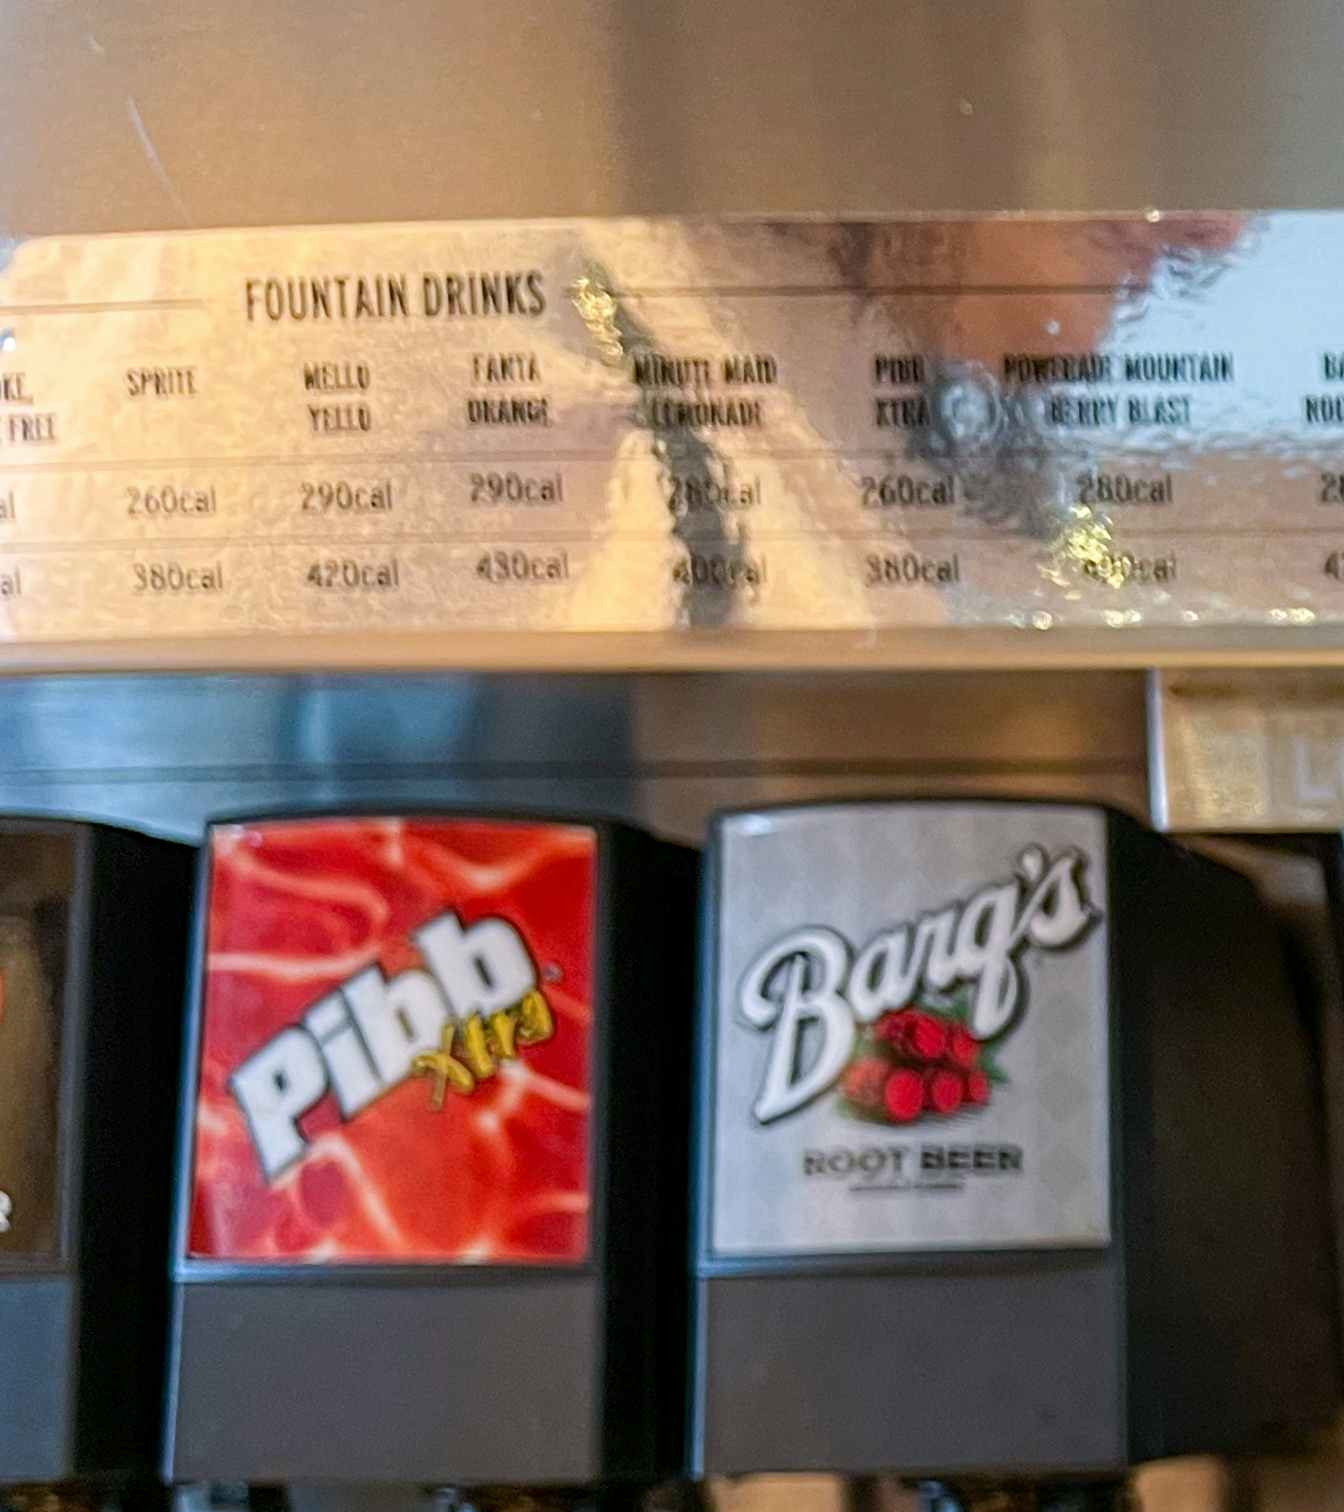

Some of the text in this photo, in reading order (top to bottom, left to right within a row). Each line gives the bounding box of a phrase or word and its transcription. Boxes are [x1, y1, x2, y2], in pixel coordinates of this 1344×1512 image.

[246, 270, 547, 321] FOUNTAIN DRINKS
[126, 366, 198, 397] SPRITE
[303, 361, 371, 391] MELLO
[471, 352, 542, 383] FANTA
[1124, 351, 1234, 383] MOUNTAIN
[0, 372, 29, 402] KE
[308, 403, 371, 432] YELLO
[466, 396, 549, 426] ORANGE
[1128, 393, 1192, 425] BLAST
[126, 484, 217, 517] 260cal
[301, 480, 393, 512] 290cal
[469, 472, 563, 504] 290cal
[861, 475, 955, 506] 260cal
[1078, 472, 1173, 505] 280cal
[133, 560, 223, 592] 380cal
[306, 557, 399, 590] 420cal
[476, 550, 569, 583] 430cal
[738, 841, 1104, 1127] Barq's
[228, 907, 541, 1187] Pibb
[803, 1143, 1024, 1177] ROOT BEER
